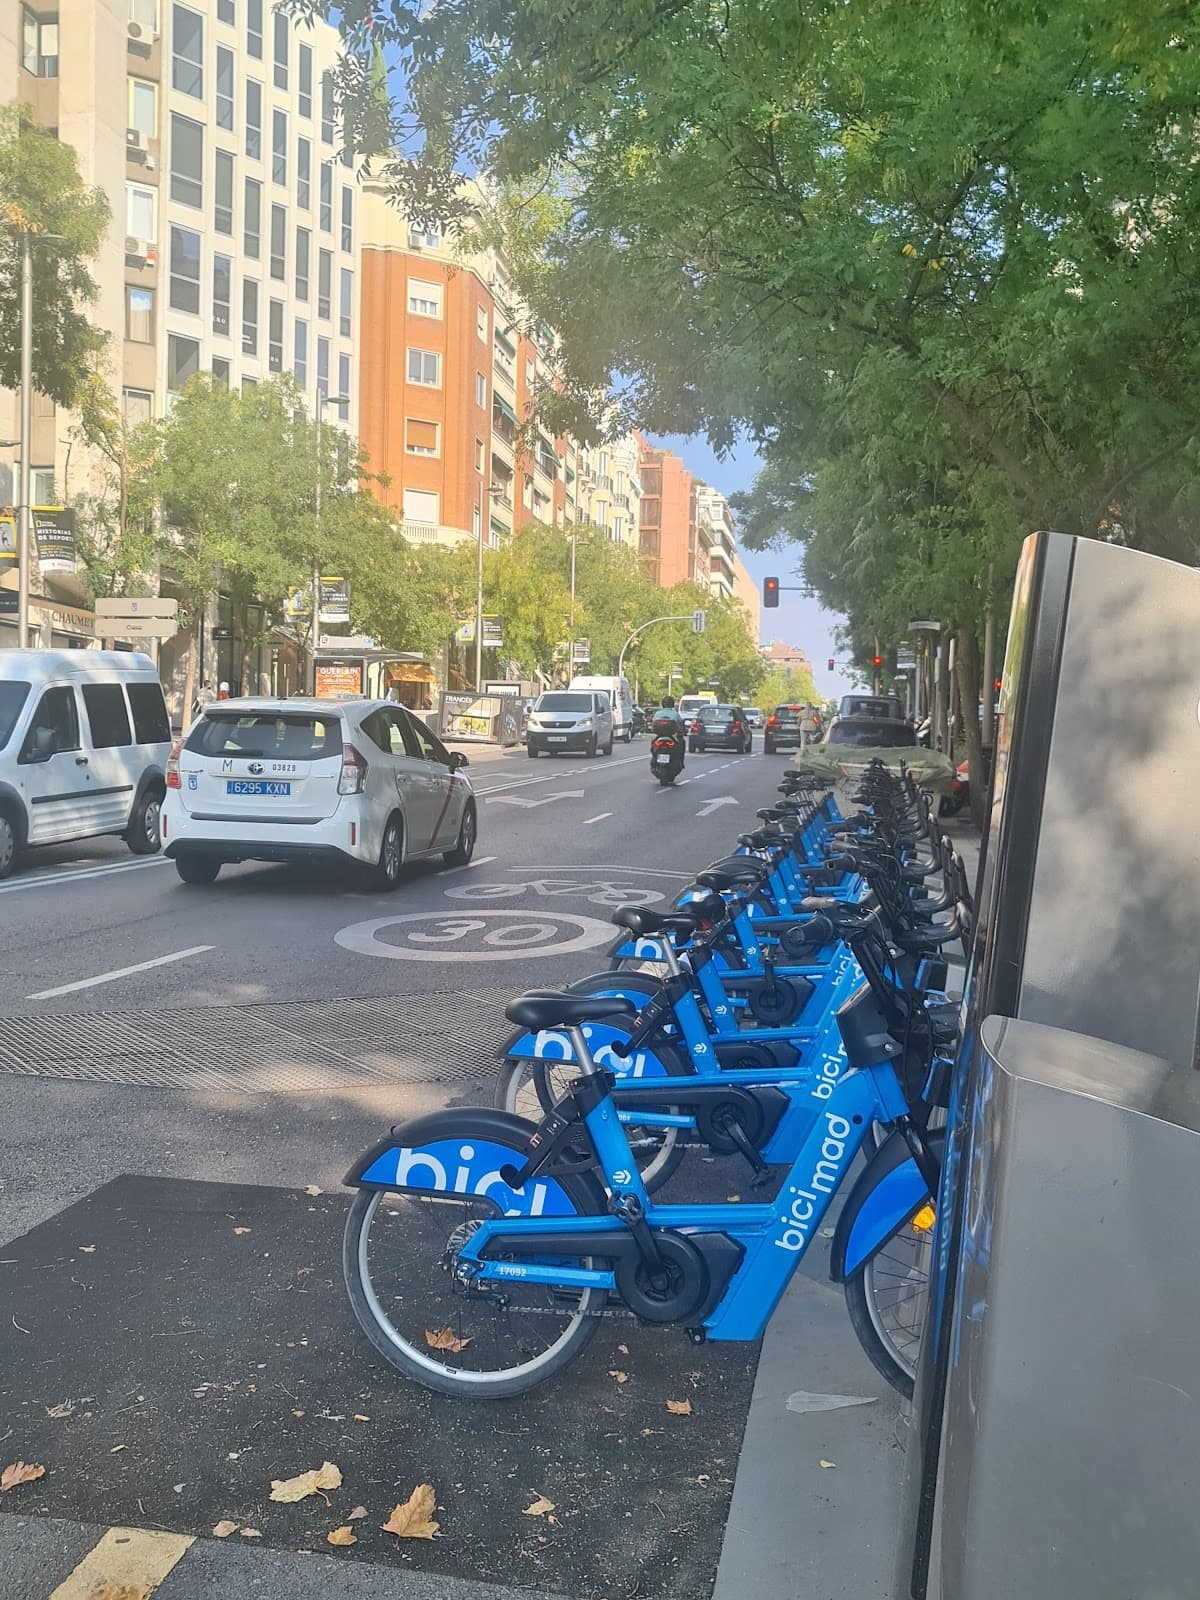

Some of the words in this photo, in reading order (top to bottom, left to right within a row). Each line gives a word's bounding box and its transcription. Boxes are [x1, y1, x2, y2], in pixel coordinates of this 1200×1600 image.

[223, 759, 233, 772] M
[234, 783, 262, 793] 6295
[266, 785, 288, 794] KXN
[408, 920, 558, 945] 30
[811, 1053, 842, 1100] bici
[774, 1186, 817, 1251] bici
[811, 1112, 850, 1194] mad
